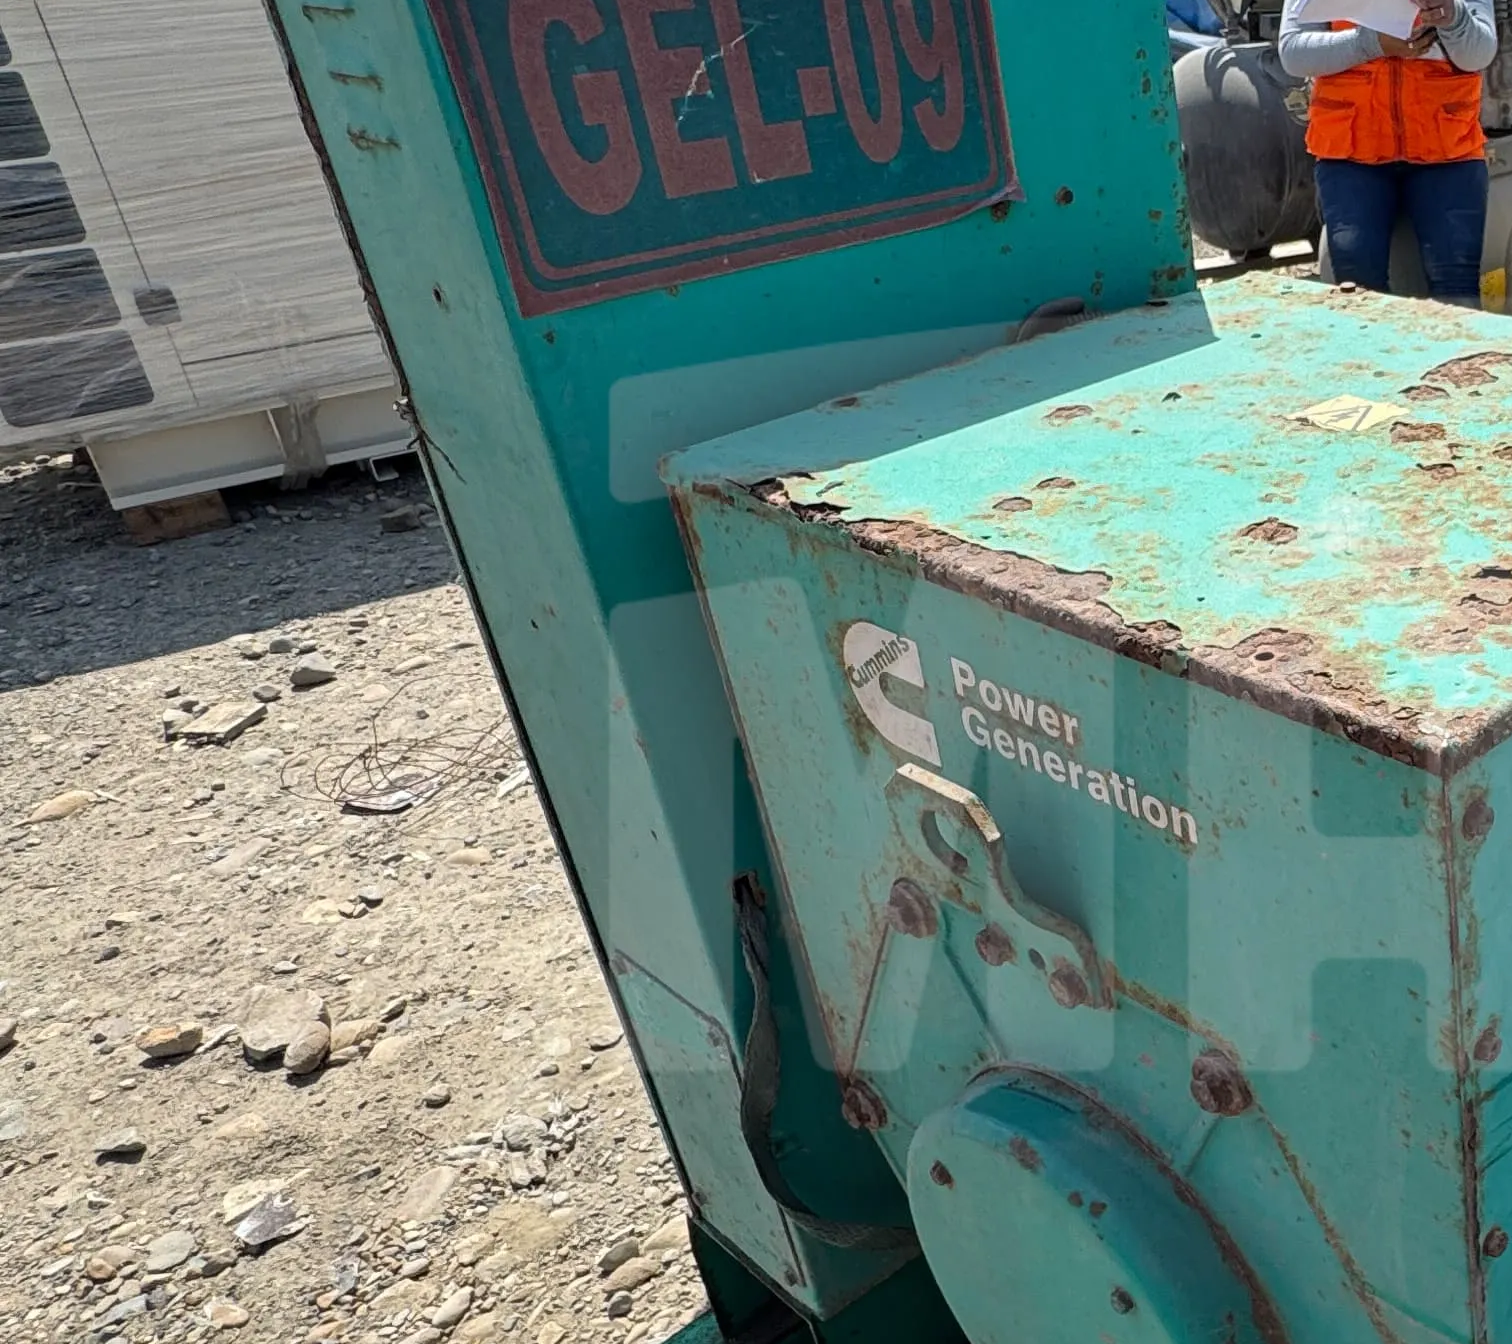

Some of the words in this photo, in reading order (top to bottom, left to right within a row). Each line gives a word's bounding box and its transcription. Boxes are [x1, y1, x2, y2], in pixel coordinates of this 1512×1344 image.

[847, 636, 910, 689] Cummins
[950, 656, 1081, 745] Power
[961, 706, 1199, 845] Generation
